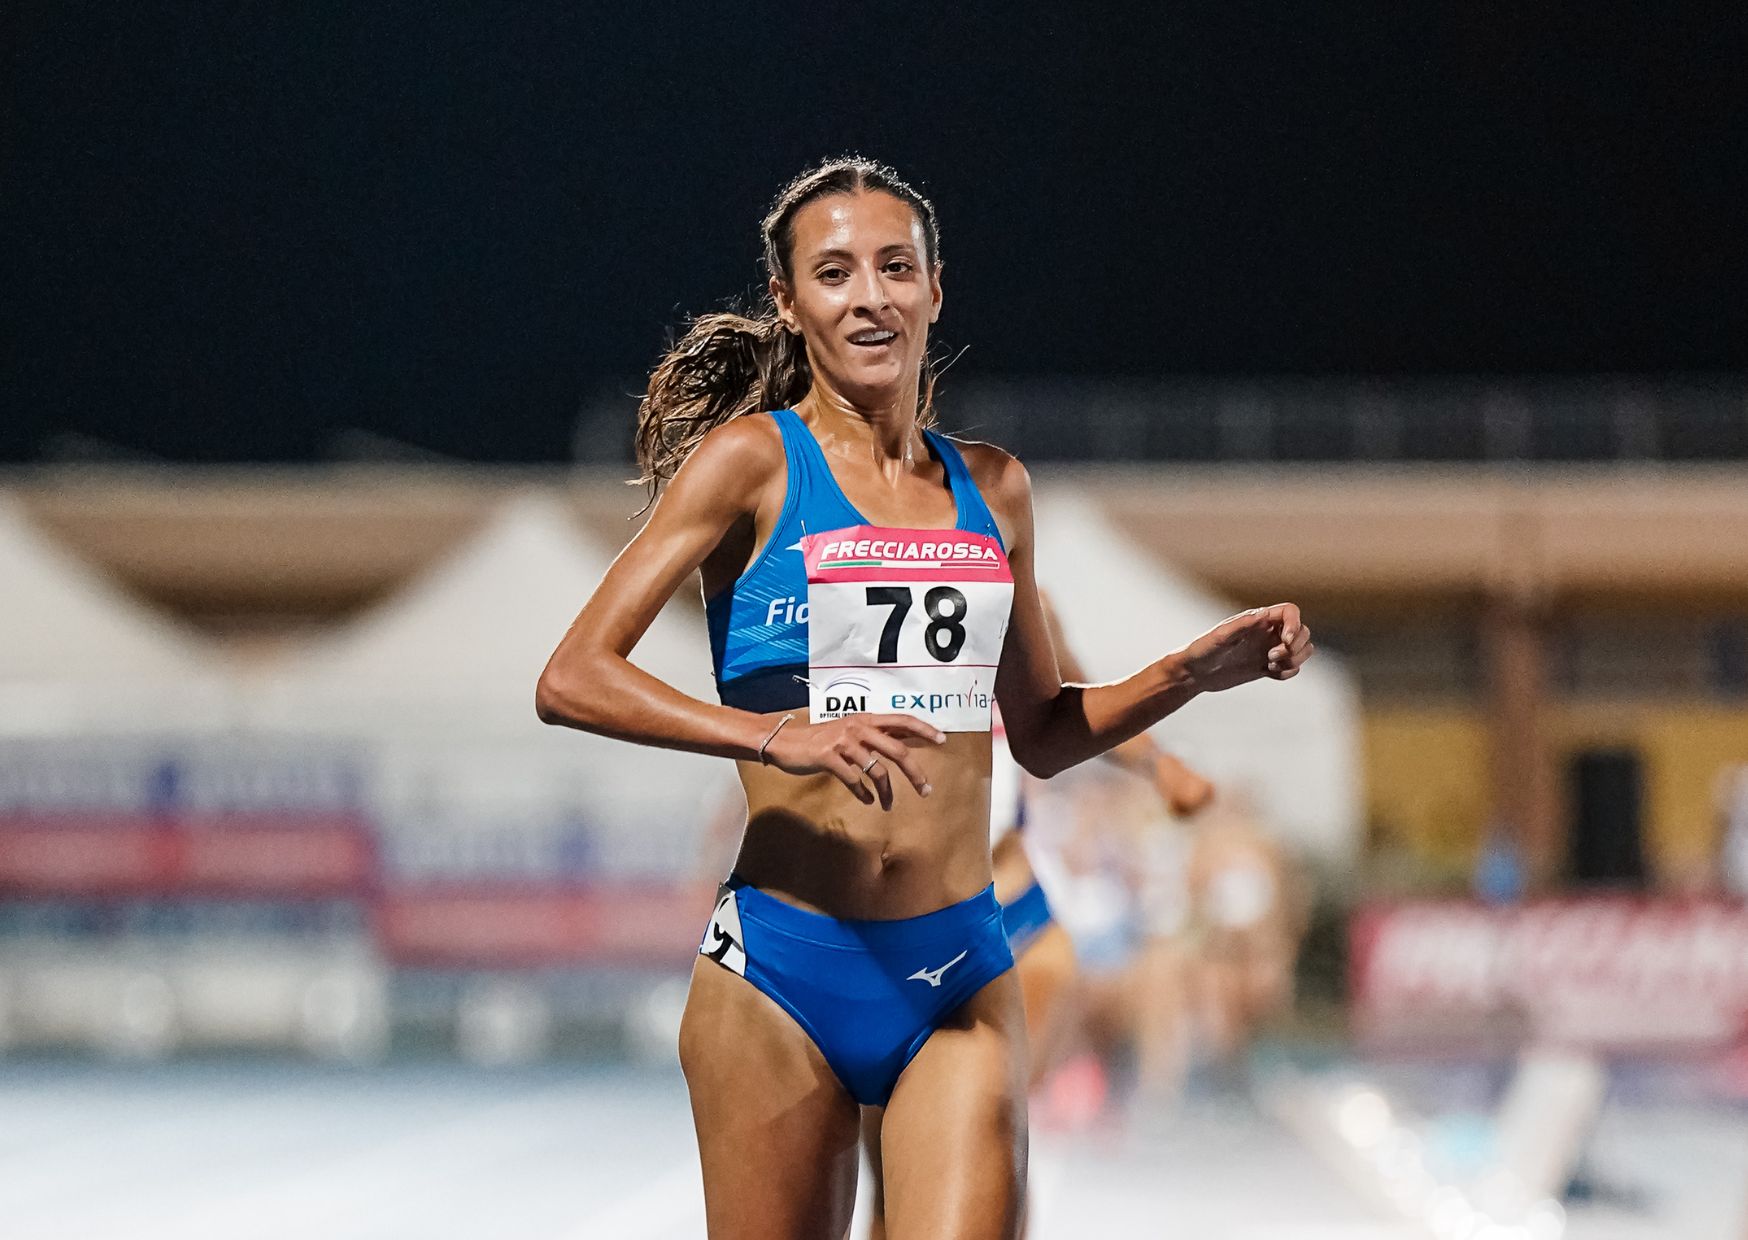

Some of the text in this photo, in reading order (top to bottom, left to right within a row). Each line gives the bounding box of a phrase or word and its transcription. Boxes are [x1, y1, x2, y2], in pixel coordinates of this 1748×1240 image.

[821, 540, 998, 560] FRECCIAROSSA
[866, 586, 967, 663] 78
[826, 696, 866, 712] DAI
[892, 680, 987, 713] exprivia
